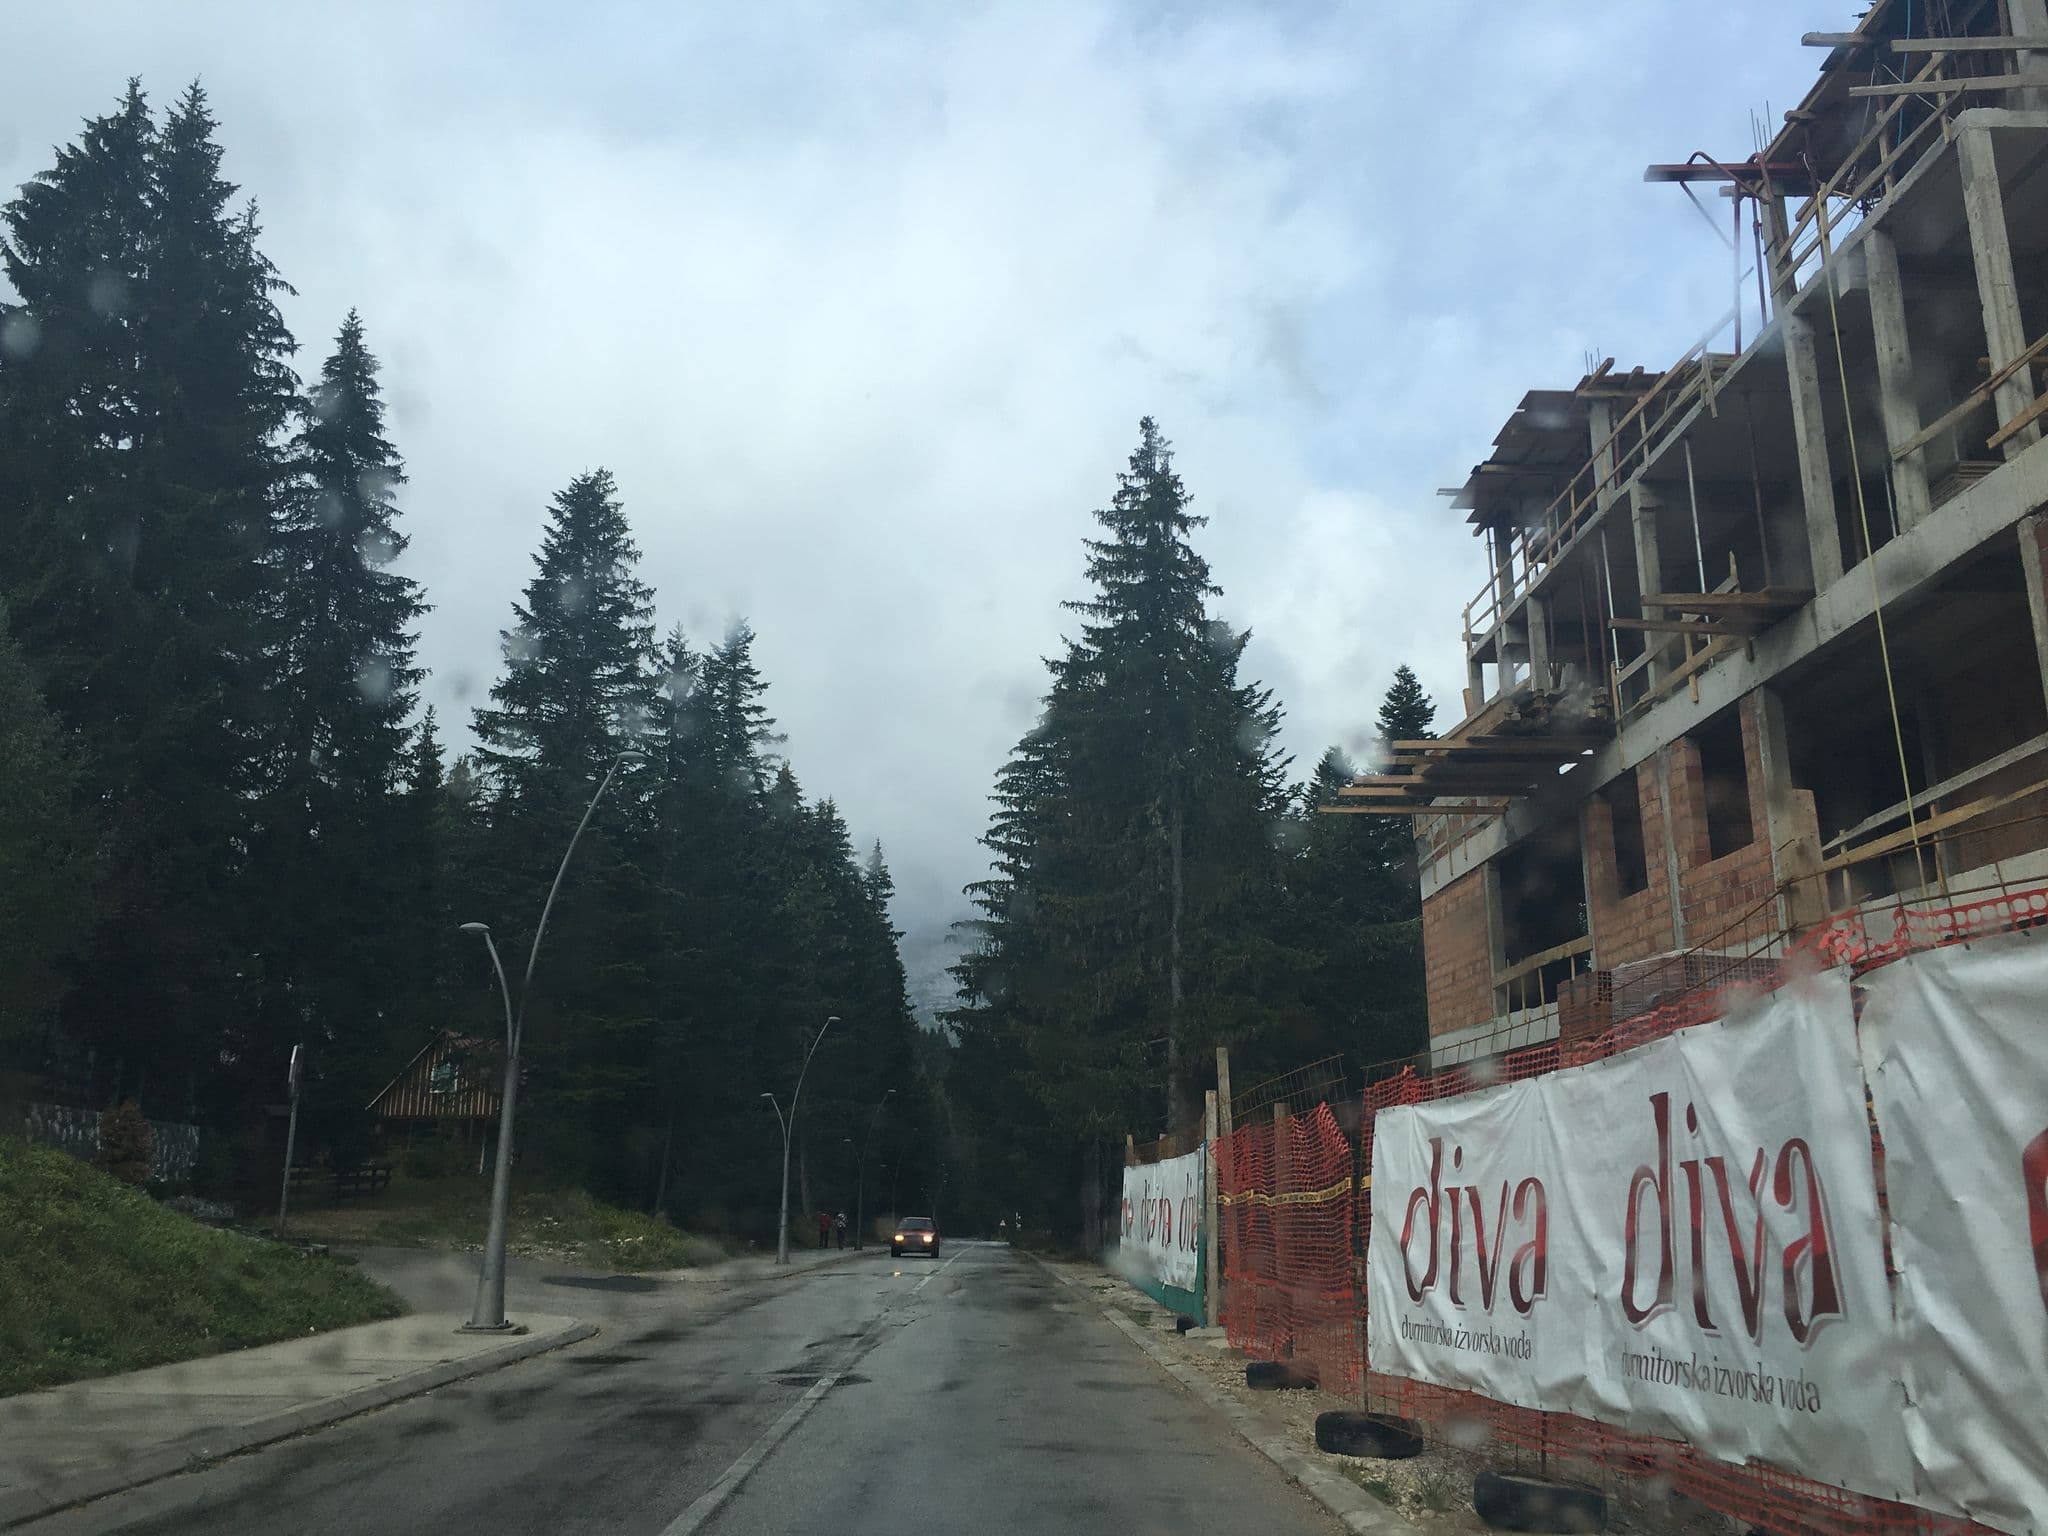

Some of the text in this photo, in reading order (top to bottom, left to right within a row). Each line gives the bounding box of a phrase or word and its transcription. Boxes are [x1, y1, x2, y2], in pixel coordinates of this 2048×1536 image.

[1401, 1137, 1547, 1316] diva
[1621, 1092, 1845, 1348] diva
[1401, 1314, 1532, 1360] durmitorska izvorska voda
[1714, 1355, 1774, 1405] izvorska
[1778, 1367, 1821, 1413] voda
